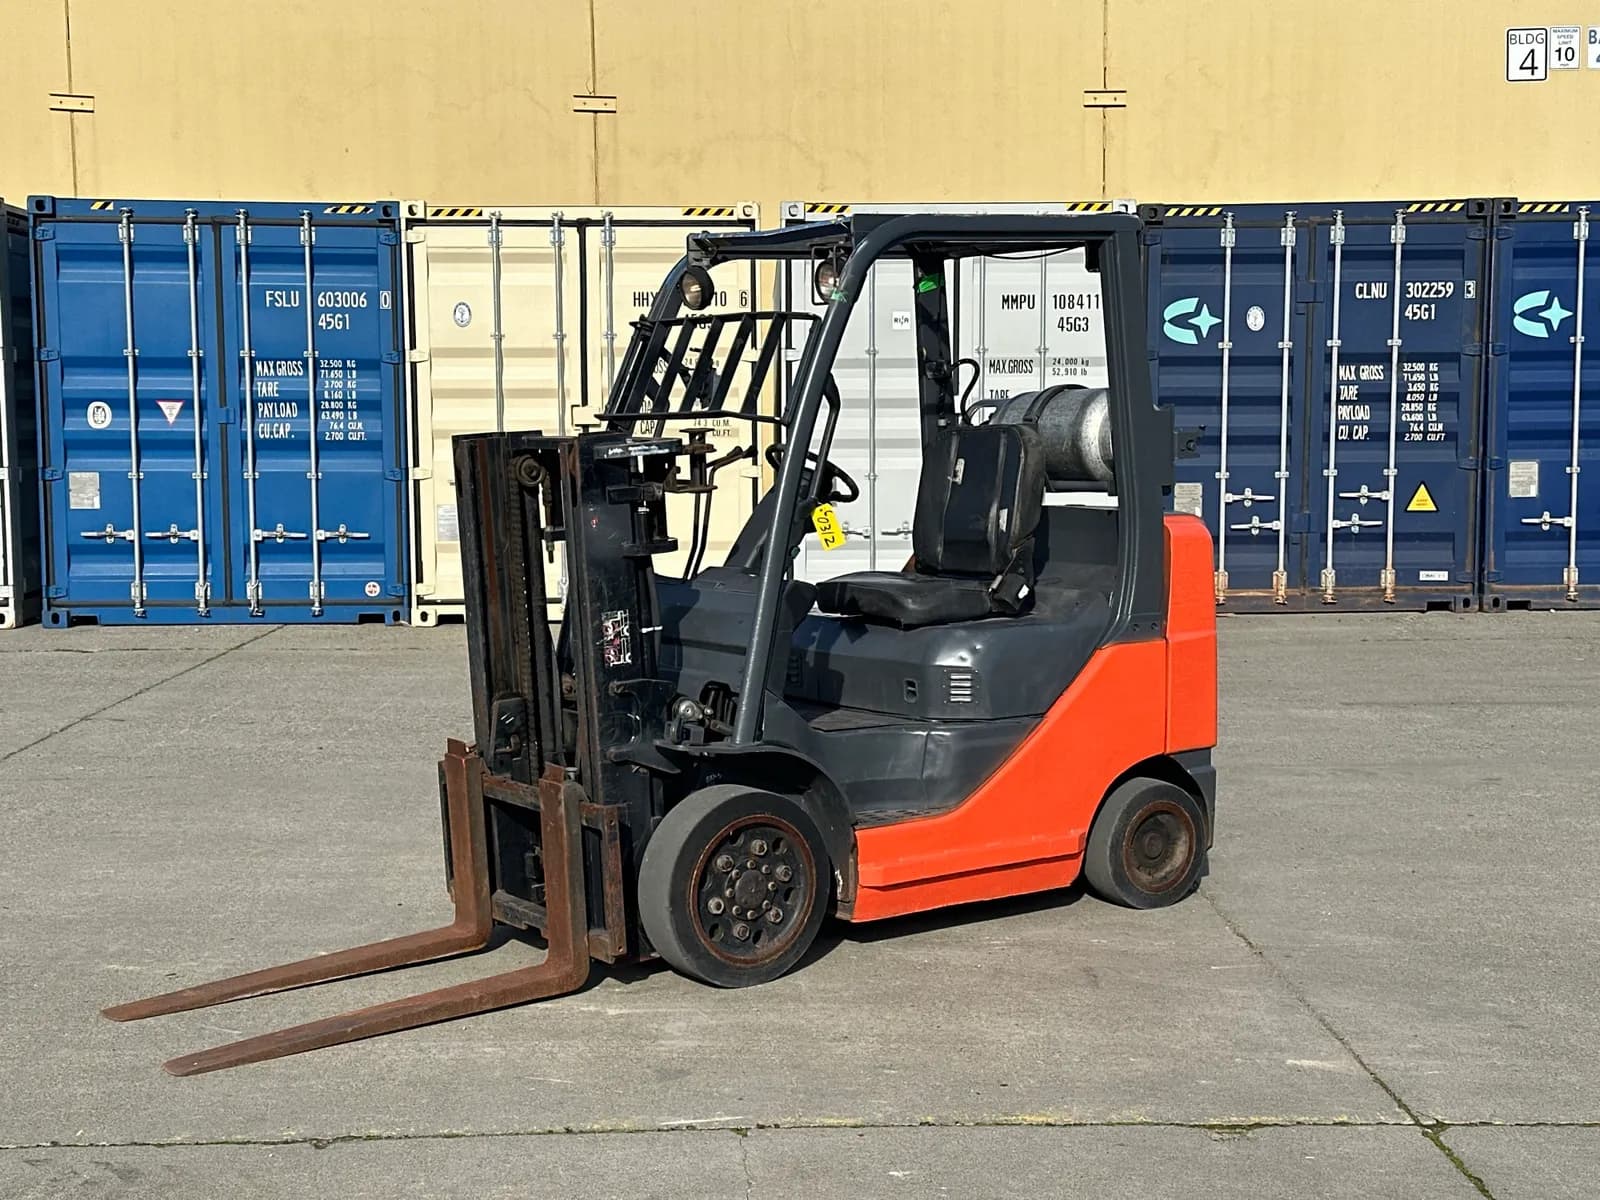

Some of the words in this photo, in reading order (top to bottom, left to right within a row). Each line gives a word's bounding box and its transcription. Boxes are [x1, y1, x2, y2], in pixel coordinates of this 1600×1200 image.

[1510, 33, 1544, 44] BLDG
[1555, 47, 1574, 61] 10
[1519, 49, 1538, 76] 4
[1355, 282, 1387, 298] CLNU
[1406, 282, 1454, 298] 302259
[1466, 282, 1475, 297] 3
[266, 291, 299, 307] FSLU
[318, 292, 367, 307] 603006
[381, 292, 391, 308] 0
[1001, 294, 1036, 309] MMPU
[1053, 294, 1099, 309] 108411
[1404, 304, 1436, 320] 45G1
[318, 314, 350, 329] 45G1
[1057, 317, 1089, 332] 45G3
[256, 361, 275, 376] MAX
[277, 361, 303, 376] GROSS
[347, 360, 356, 368] KG
[1429, 363, 1438, 371] KG
[347, 370, 356, 378] LB
[1339, 365, 1356, 380] MAX
[1360, 365, 1384, 380] GROSS
[1429, 373, 1438, 381] LB
[257, 382, 279, 397] TARE
[1340, 386, 1358, 400] TARE
[258, 402, 297, 418] PAYLOAD
[348, 401, 357, 409] KG
[1338, 405, 1370, 420] PAYLOAD
[348, 411, 357, 419] LB
